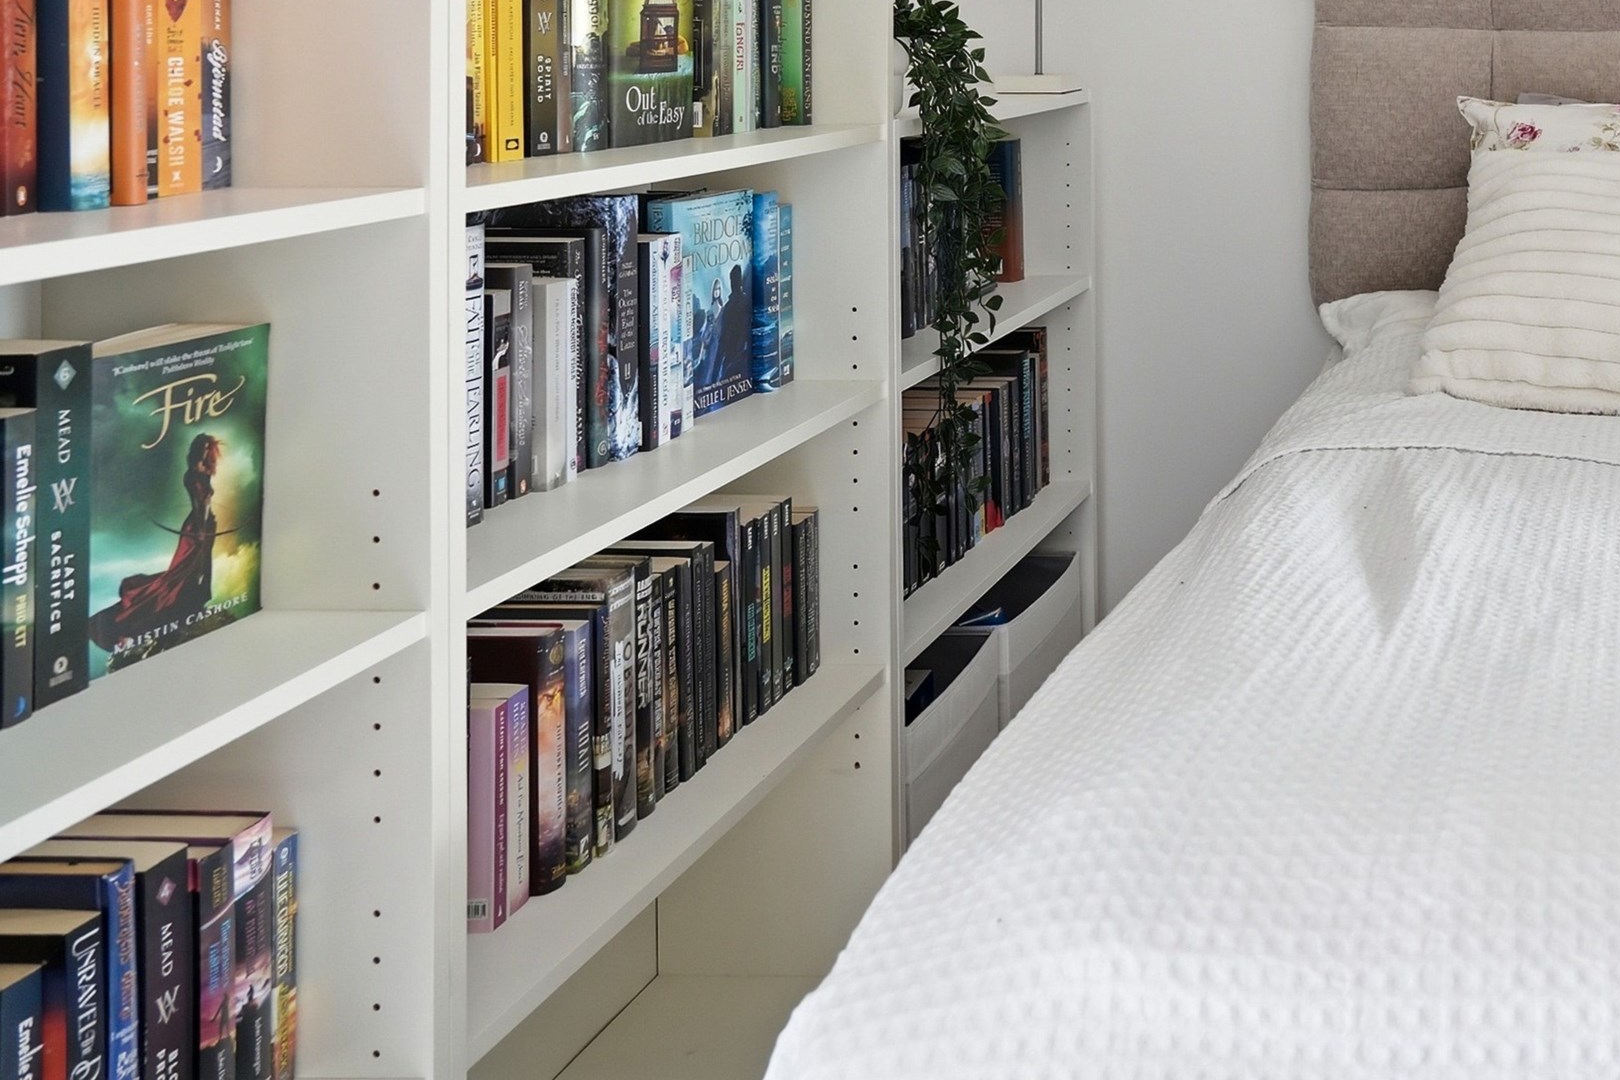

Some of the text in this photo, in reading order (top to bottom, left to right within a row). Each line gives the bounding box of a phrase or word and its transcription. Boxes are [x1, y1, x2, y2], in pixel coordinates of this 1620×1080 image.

[92, 6, 101, 57] HIDDEN
[770, 44, 779, 75] END
[166, 56, 185, 167] CHLOE WALSH
[206, 39, 229, 142] Björnstad
[625, 85, 658, 112] Out
[659, 100, 686, 130] Easy
[692, 239, 750, 270] INGDOM
[57, 409, 72, 465] MEAD
[131, 372, 246, 450] Fire
[465, 376, 482, 488] TEARLING
[3, 444, 37, 586] Emelie Schepp
[49, 530, 62, 635] SACRIFICE
[63, 553, 76, 601] LAST
[113, 590, 250, 657] KRISTIN CASHORE
[637, 604, 649, 710] RUNNER
[161, 921, 174, 977] MEAD
[71, 927, 101, 1042] UNRAVEL
[17, 1015, 46, 1076] Emelie
